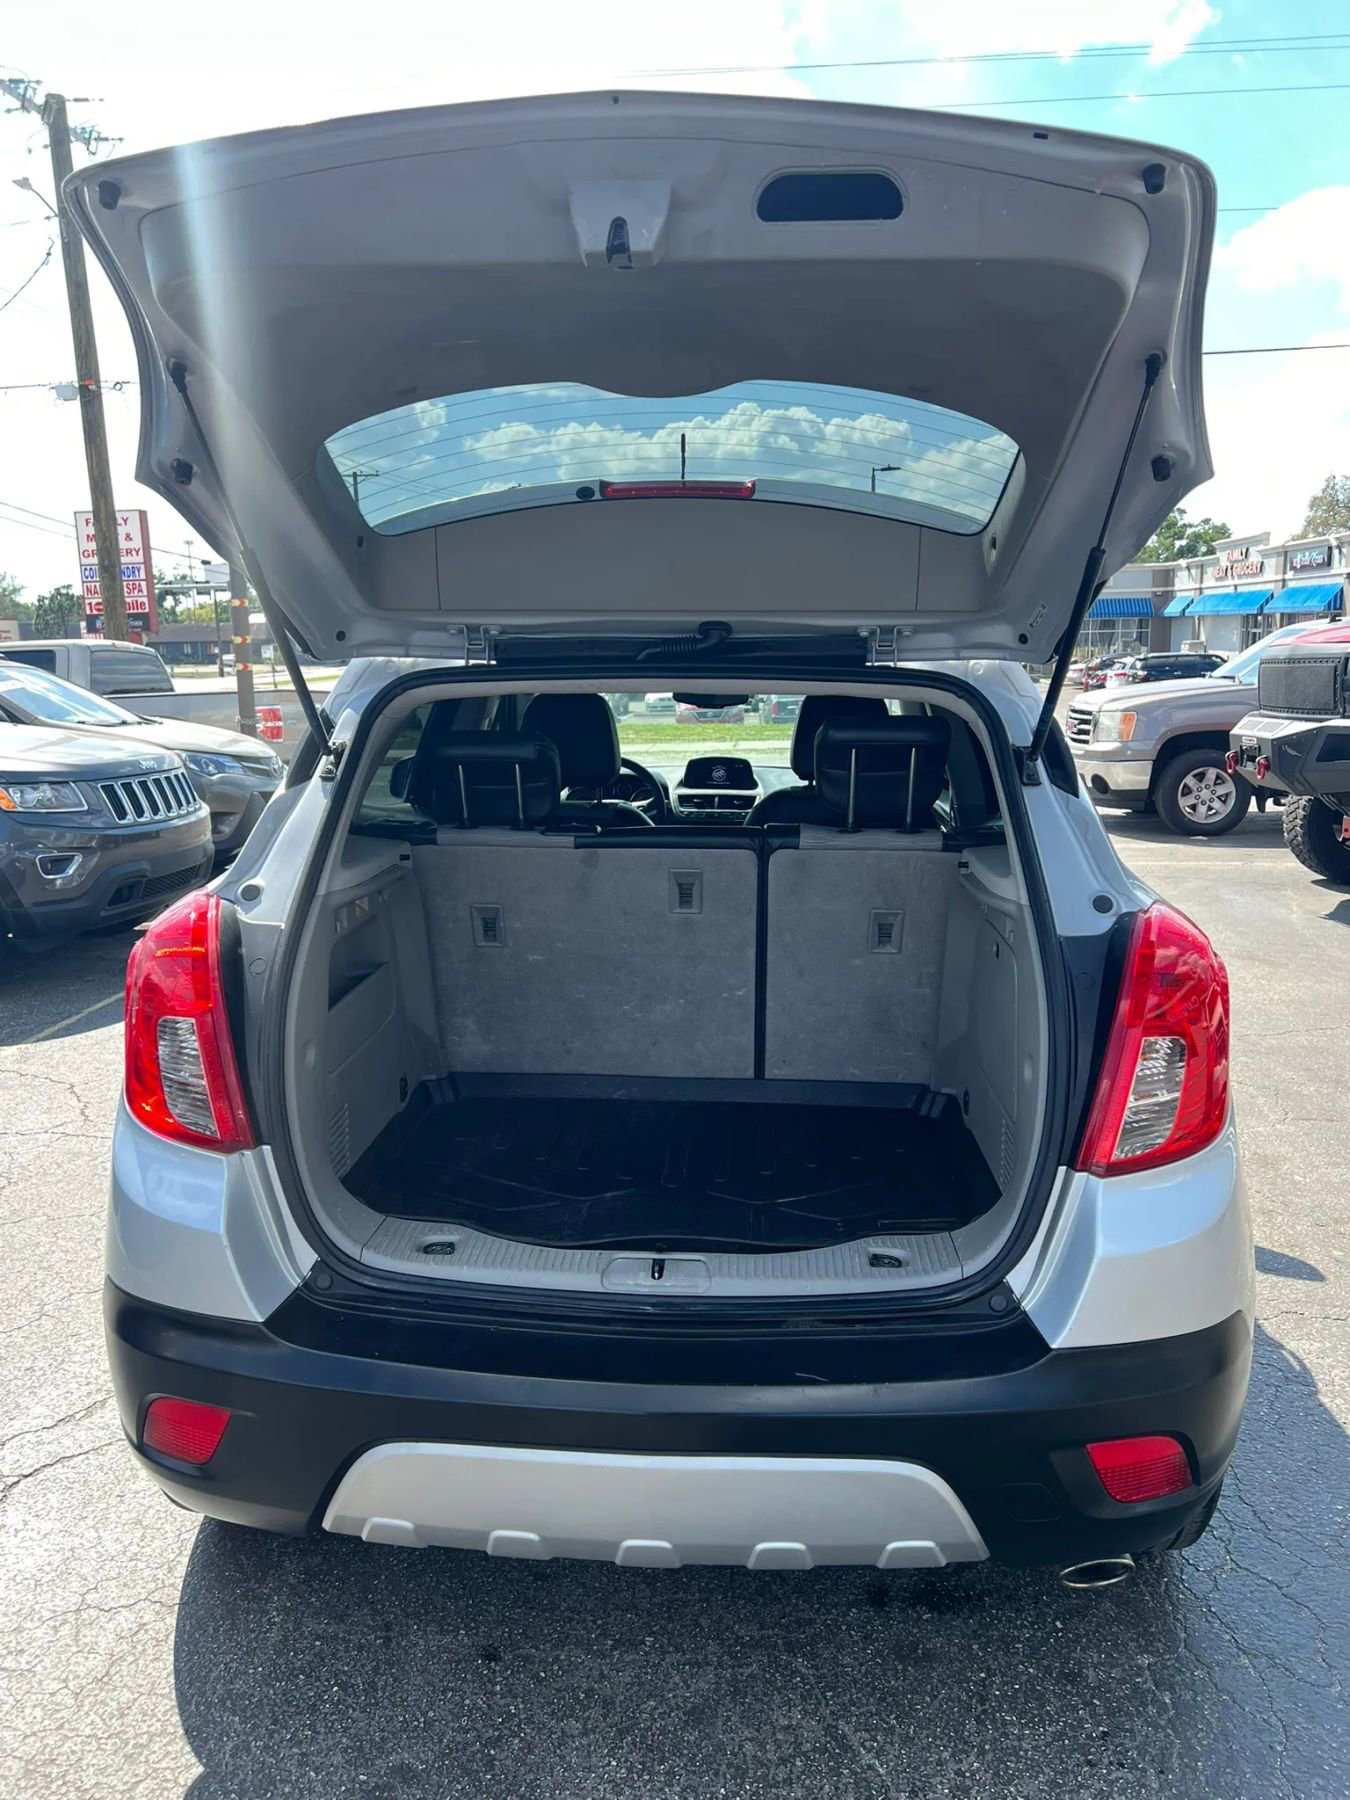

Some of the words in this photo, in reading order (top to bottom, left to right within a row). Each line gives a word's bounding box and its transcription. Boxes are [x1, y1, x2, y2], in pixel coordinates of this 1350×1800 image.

[85, 517, 129, 527] FLY
[82, 547, 141, 559] GRERY
[84, 567, 98, 579] COI
[126, 582, 143, 595] SPA
